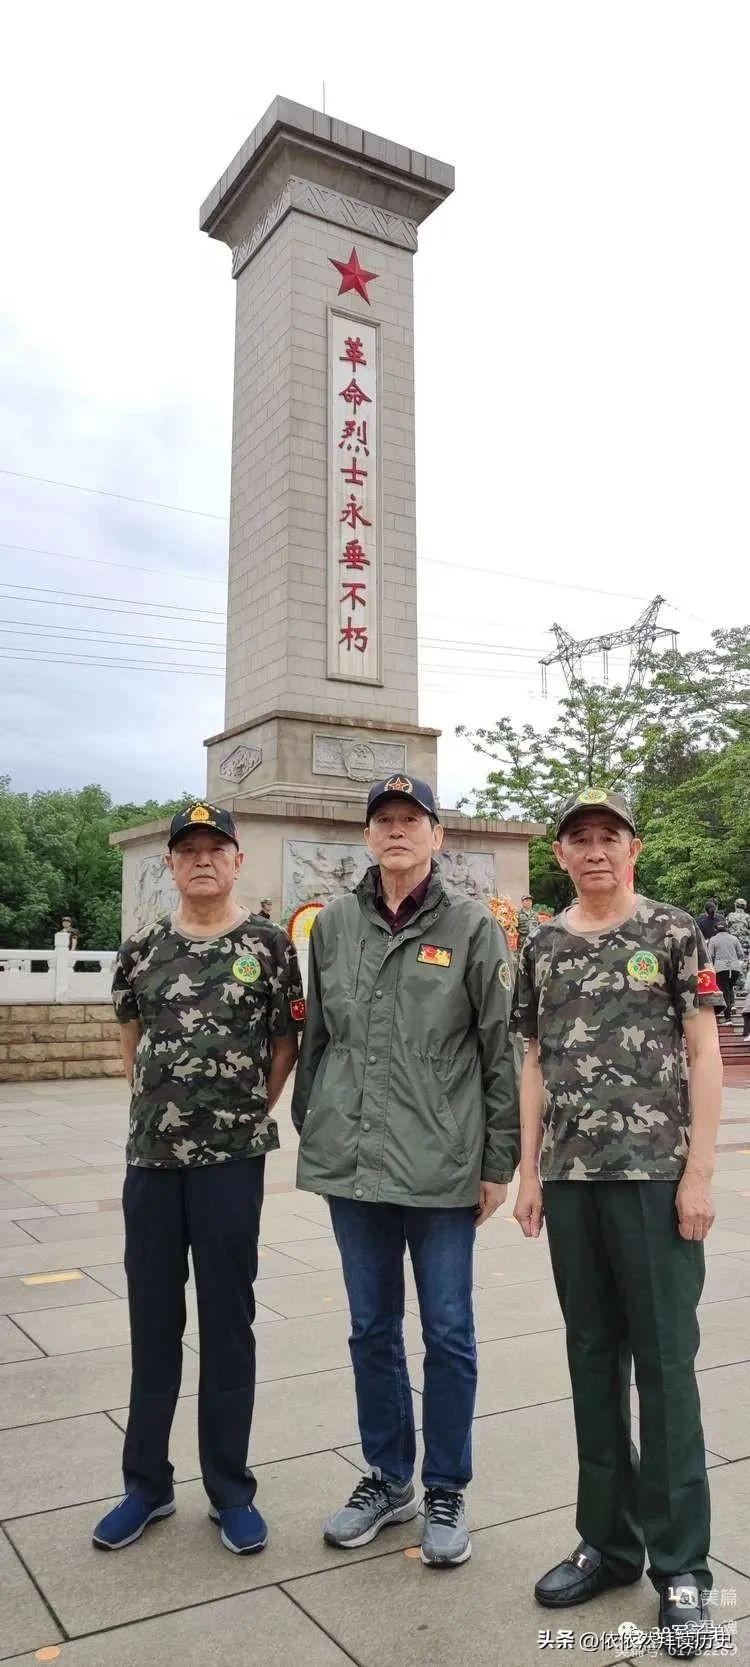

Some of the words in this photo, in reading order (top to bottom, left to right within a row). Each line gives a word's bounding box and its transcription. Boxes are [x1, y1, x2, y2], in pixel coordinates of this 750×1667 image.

[338, 336, 372, 654] 革命烈士永垂不朽
